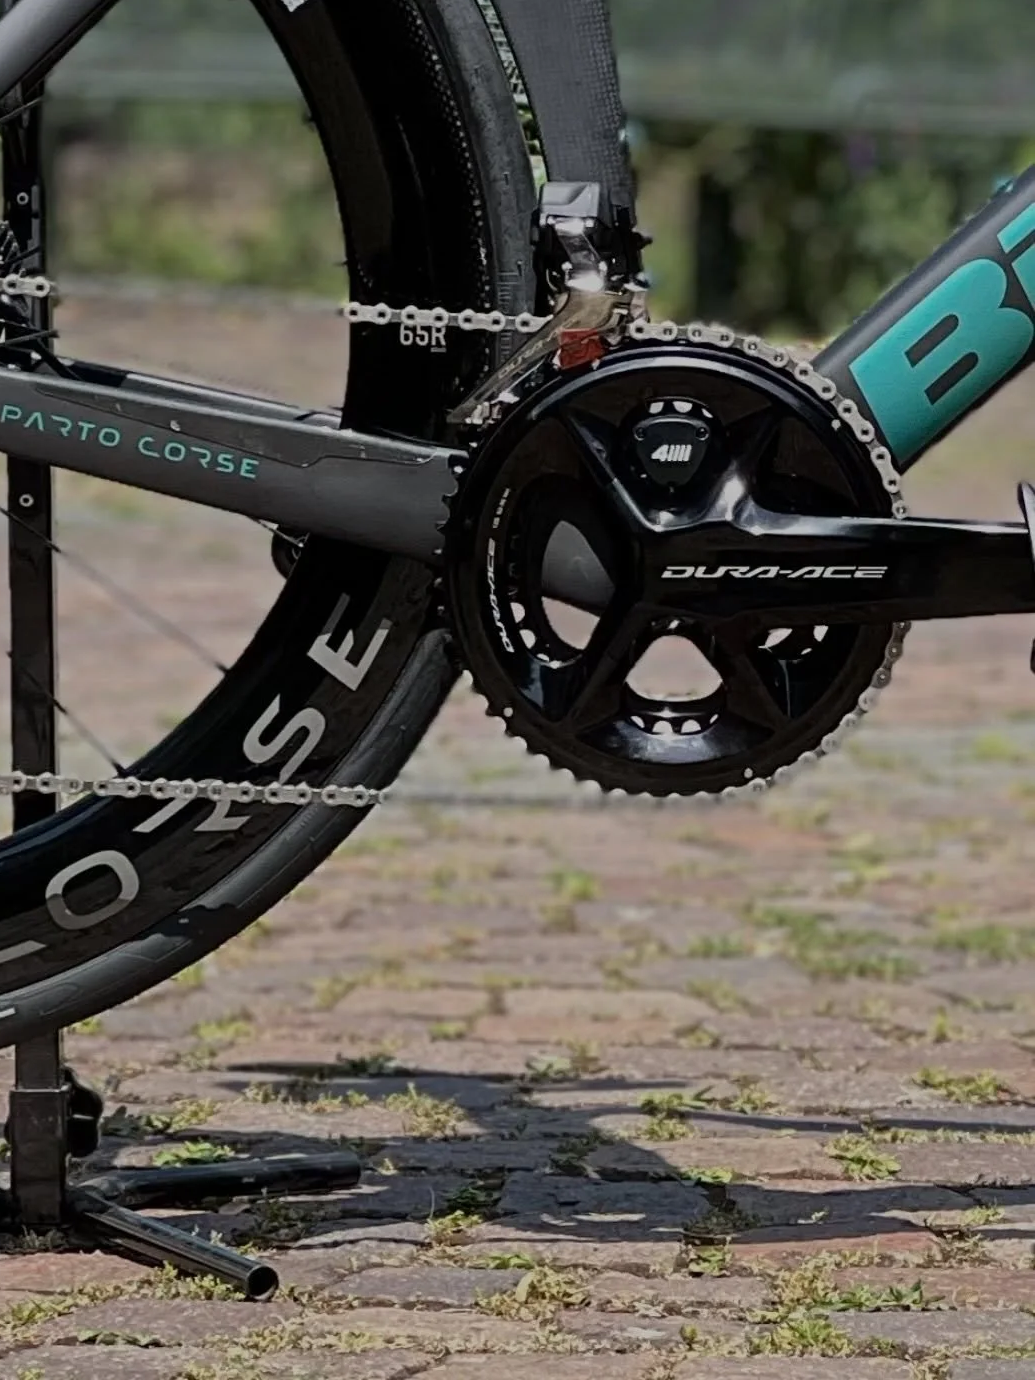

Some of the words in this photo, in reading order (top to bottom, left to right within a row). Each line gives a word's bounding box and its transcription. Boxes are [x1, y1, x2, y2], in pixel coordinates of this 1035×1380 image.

[399, 324, 447, 349] 65R
[137, 435, 260, 479] CORSE
[660, 565, 889, 580] DURA-ACE
